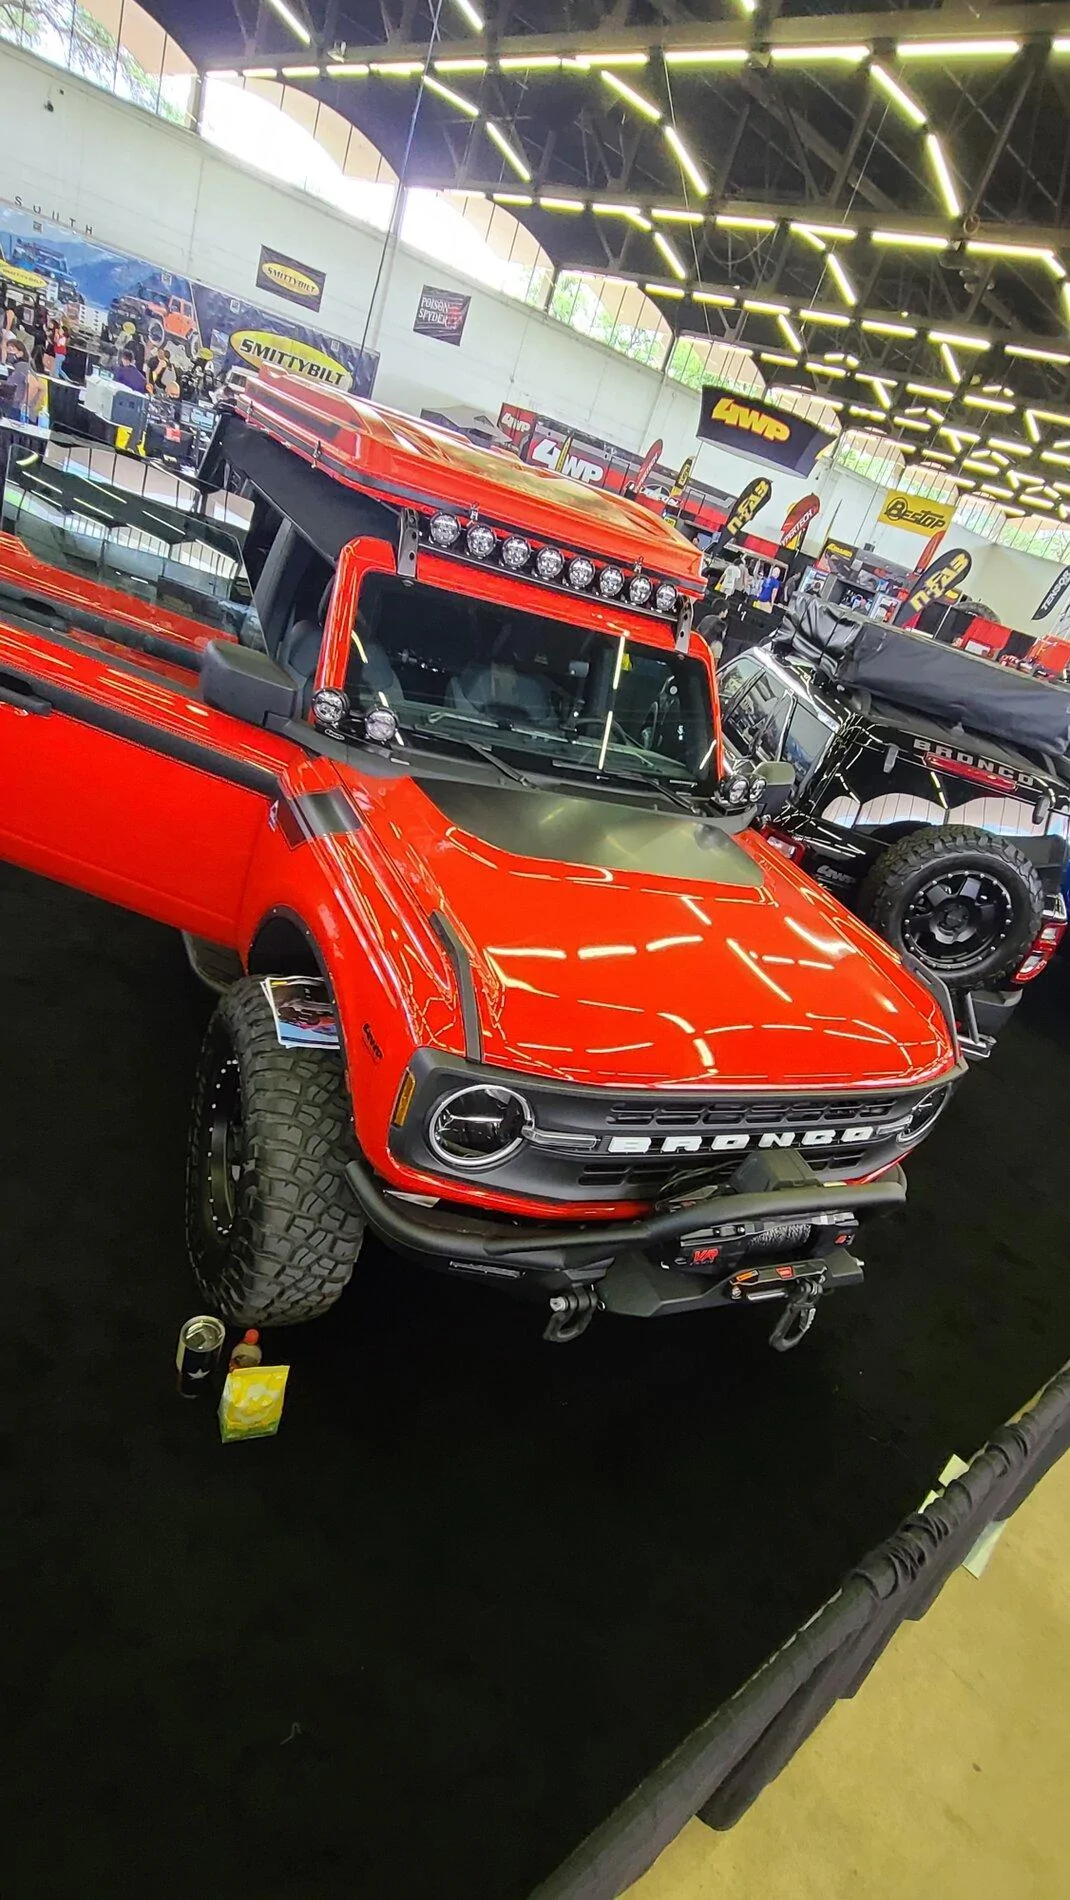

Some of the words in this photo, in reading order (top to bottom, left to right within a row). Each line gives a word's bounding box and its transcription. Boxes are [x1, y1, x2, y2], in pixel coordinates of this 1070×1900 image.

[15, 196, 93, 234] SOUTH
[267, 267, 316, 293] SMITTYBILT
[421, 297, 449, 313] POISON
[240, 338, 345, 386] SMITTYBILT
[501, 412, 531, 433] 4WP
[711, 397, 791, 442] 4WP
[531, 438, 604, 483] 4WP
[913, 738, 1034, 788] BRONCO
[608, 1126, 874, 1153] BRONCO
